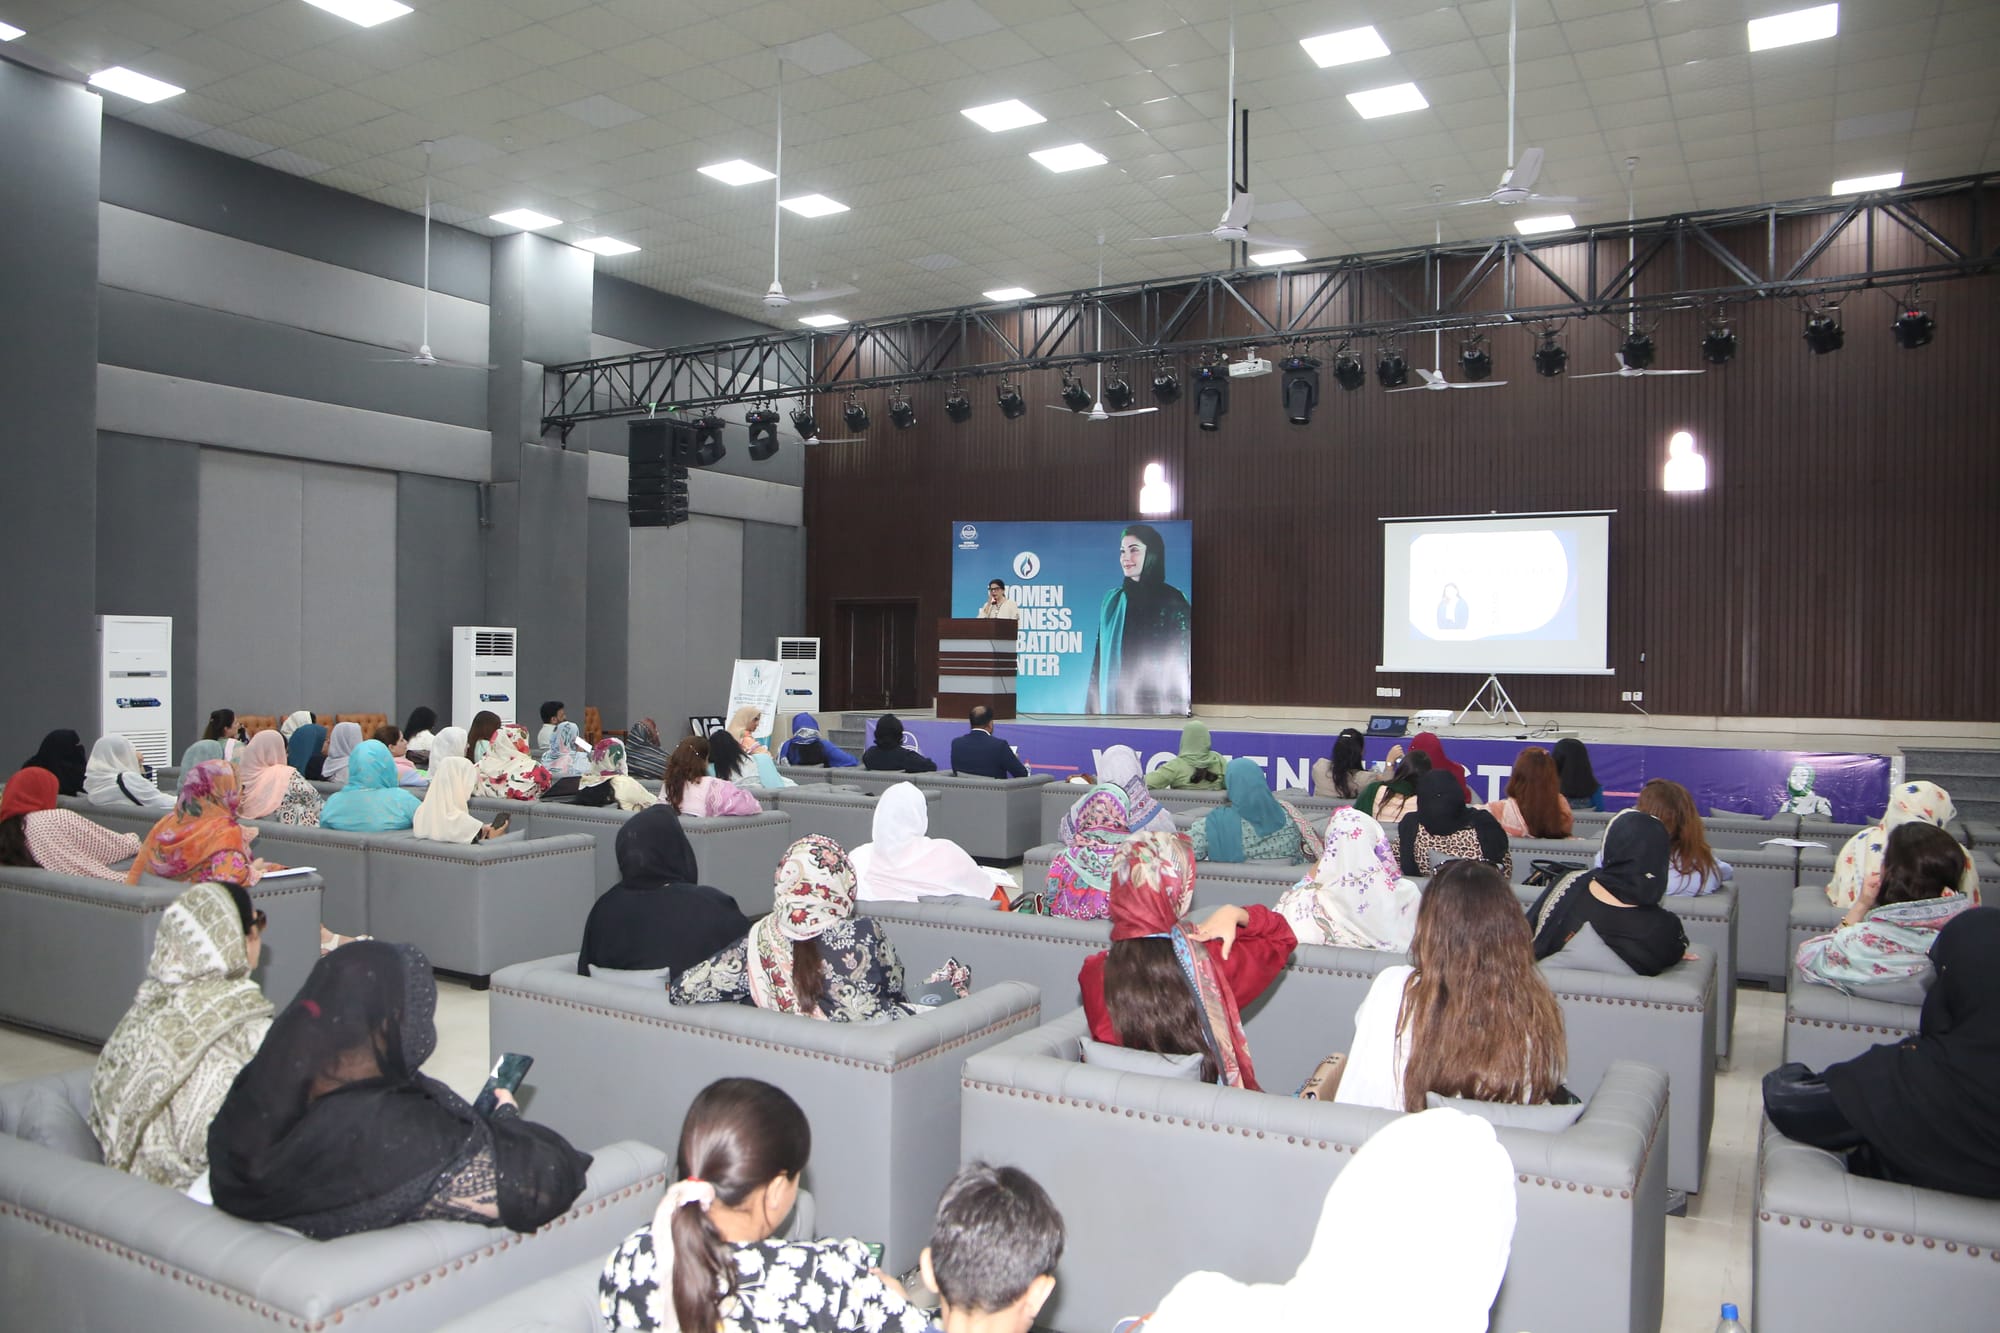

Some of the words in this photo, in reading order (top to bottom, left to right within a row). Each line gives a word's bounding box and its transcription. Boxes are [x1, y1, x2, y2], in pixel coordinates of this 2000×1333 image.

[1017, 608, 1072, 630] INESS
[1016, 631, 1083, 653] BATION
[1016, 654, 1060, 676] NTER
